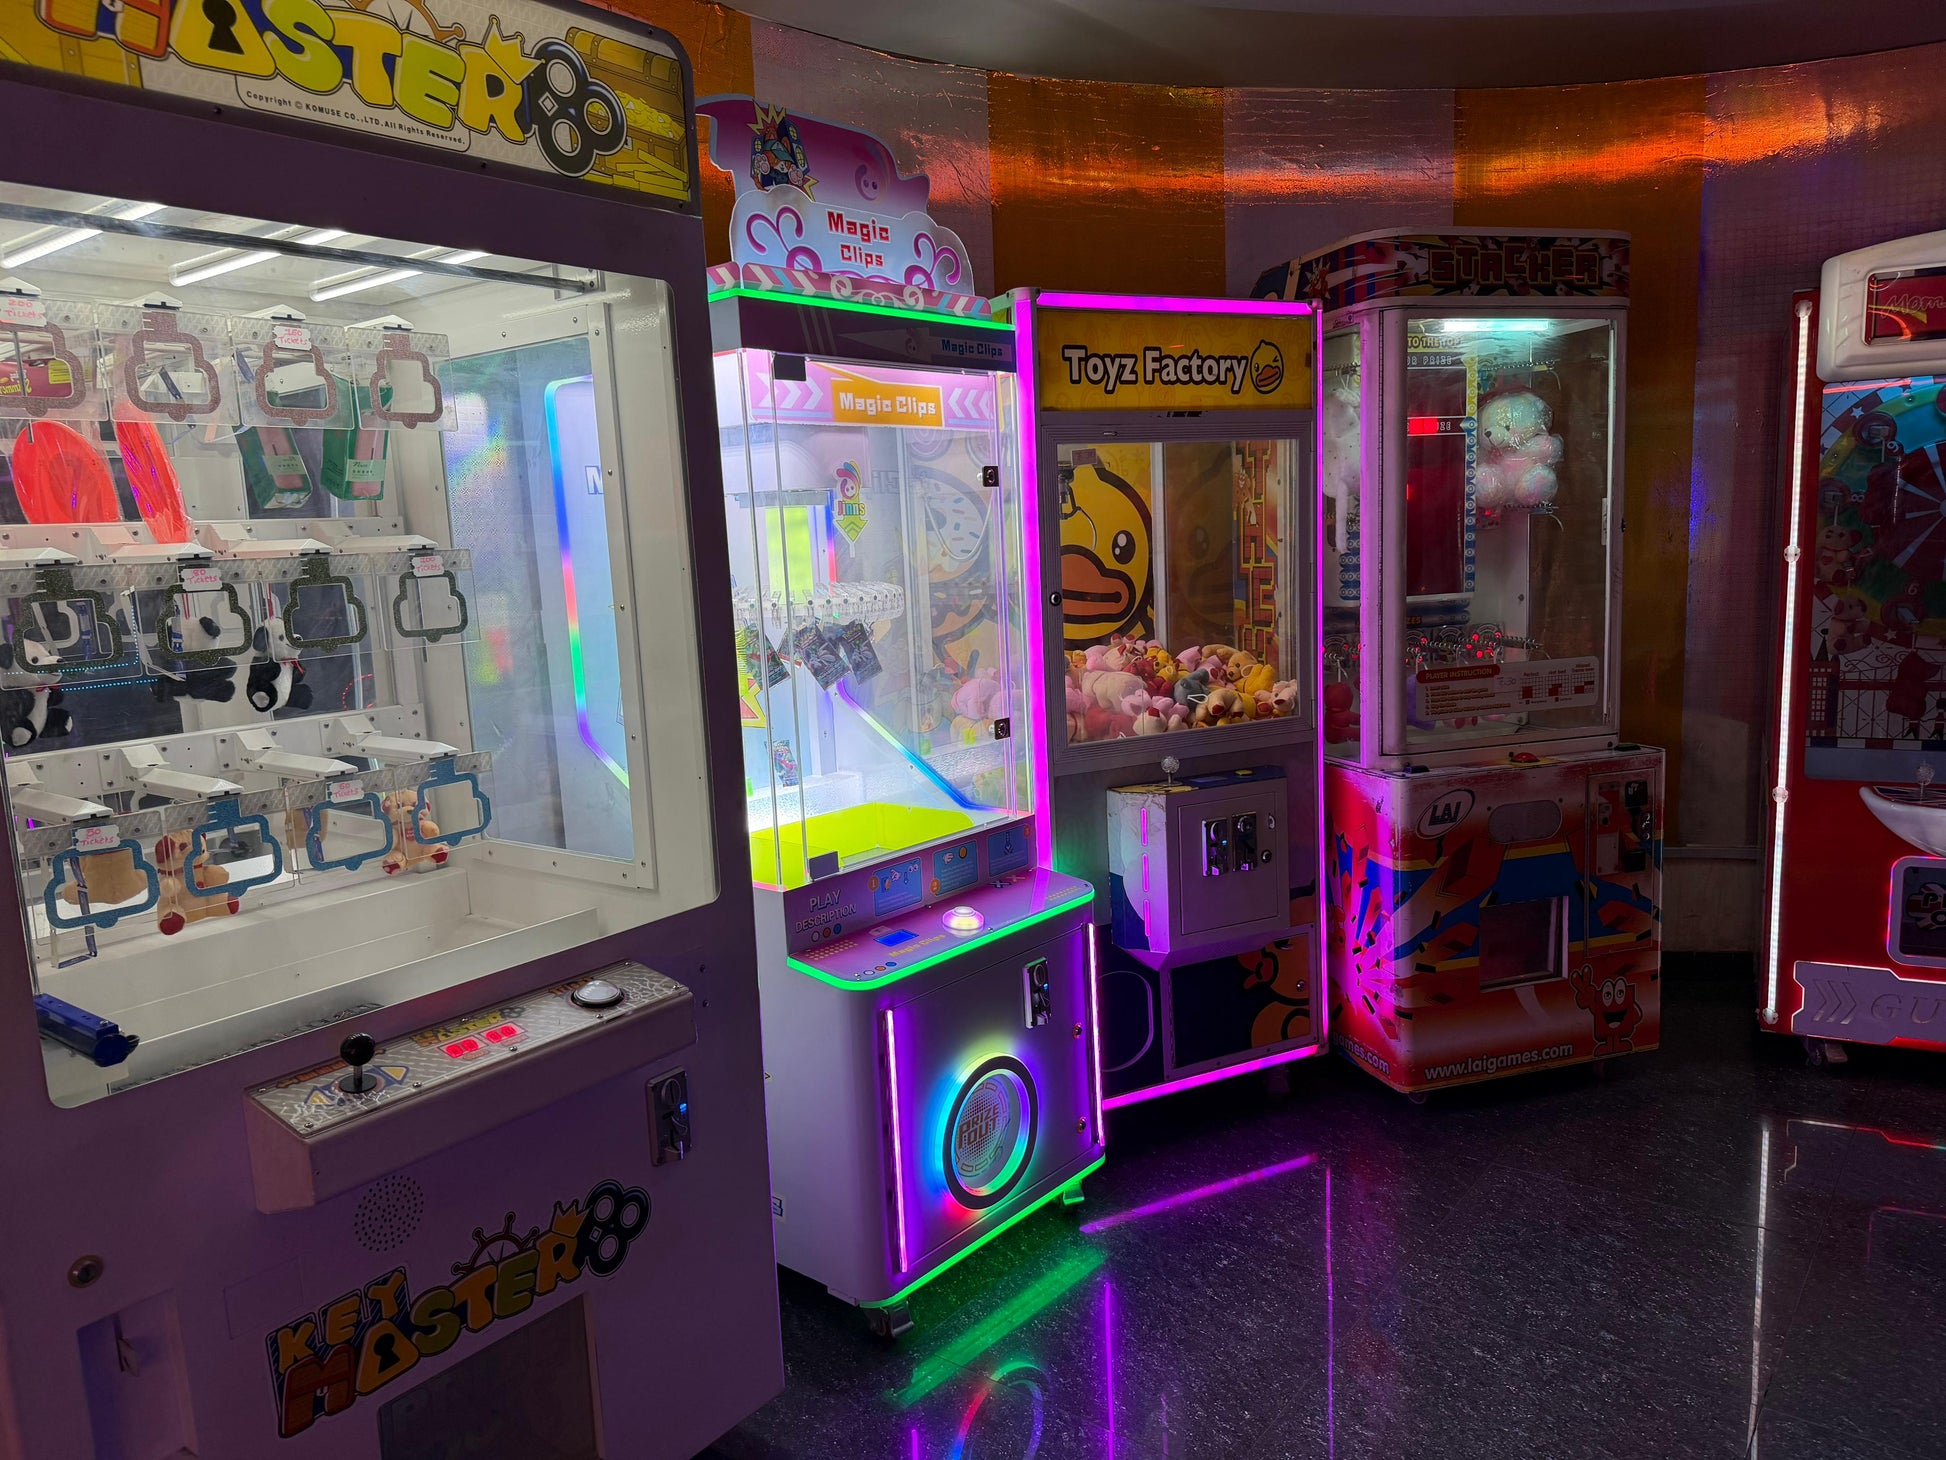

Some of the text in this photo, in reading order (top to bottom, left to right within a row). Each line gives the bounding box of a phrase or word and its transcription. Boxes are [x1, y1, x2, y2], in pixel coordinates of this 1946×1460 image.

[246, 90, 292, 107] Copyright
[305, 103, 342, 117] KOMUSE
[398, 123, 424, 136] Rights
[426, 129, 466, 145] Reserved.
[826, 210, 890, 244] Magic
[840, 244, 884, 269] Clips
[1429, 243, 1600, 286] STACKER
[941, 339, 1003, 358] Magic Clips
[1421, 335, 1438, 348] THE
[1063, 346, 1248, 393] Toyz Factory
[839, 392, 936, 418] Magic Clips
[186, 575, 219, 585] Tickets
[1425, 667, 1492, 680] PLAYER INSTRUCTION
[1428, 801, 1462, 827] LAI
[79, 835, 114, 846] Tickets
[809, 889, 841, 913] PLAY
[795, 903, 857, 934] DESCRIPTION
[1424, 1042, 1574, 1081] www.laigames.com
[959, 1103, 1000, 1150] PRIZE
[967, 1118, 998, 1146] OUT
[276, 1269, 407, 1376] KEY
[280, 1230, 583, 1438] MASTER
